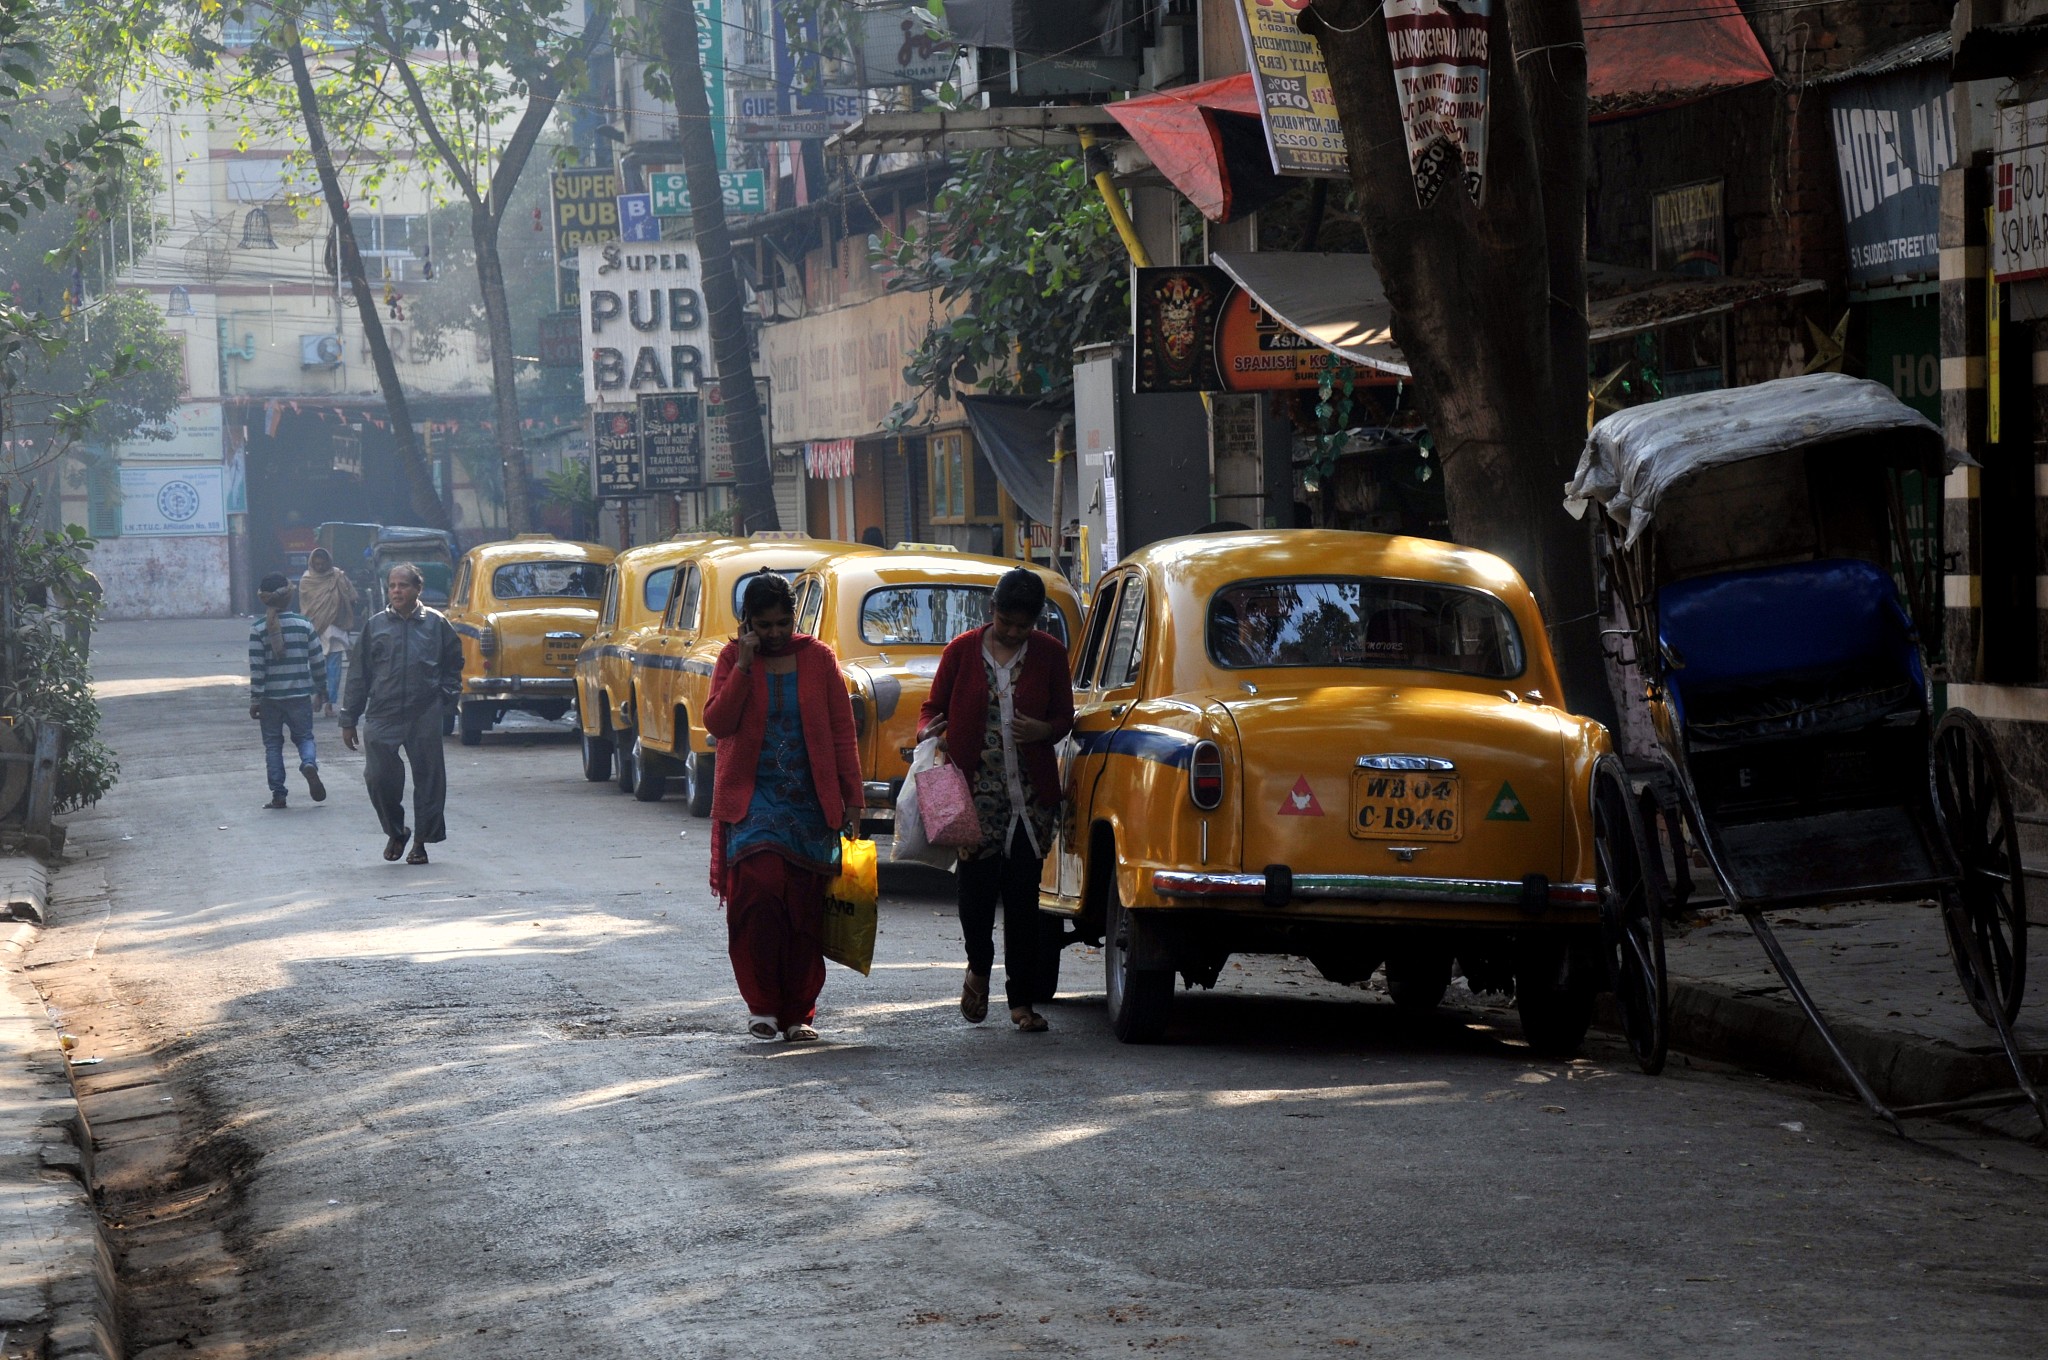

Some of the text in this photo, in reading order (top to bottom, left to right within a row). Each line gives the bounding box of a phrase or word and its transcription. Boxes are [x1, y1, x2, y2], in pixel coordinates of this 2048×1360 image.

[1833, 108, 1912, 223] HOTEL
[555, 175, 616, 199] SUPER
[655, 188, 760, 208] HOSE
[560, 201, 617, 227] PUB
[598, 244, 690, 276] SUPER
[1889, 235, 1926, 261] STREET
[590, 287, 701, 334] PUB
[1269, 332, 1308, 348] ASIA
[592, 344, 703, 391] BAR
[1234, 355, 1298, 371] SPANISH
[649, 456, 673, 465] TRAVEL
[1367, 777, 1406, 799] WB
